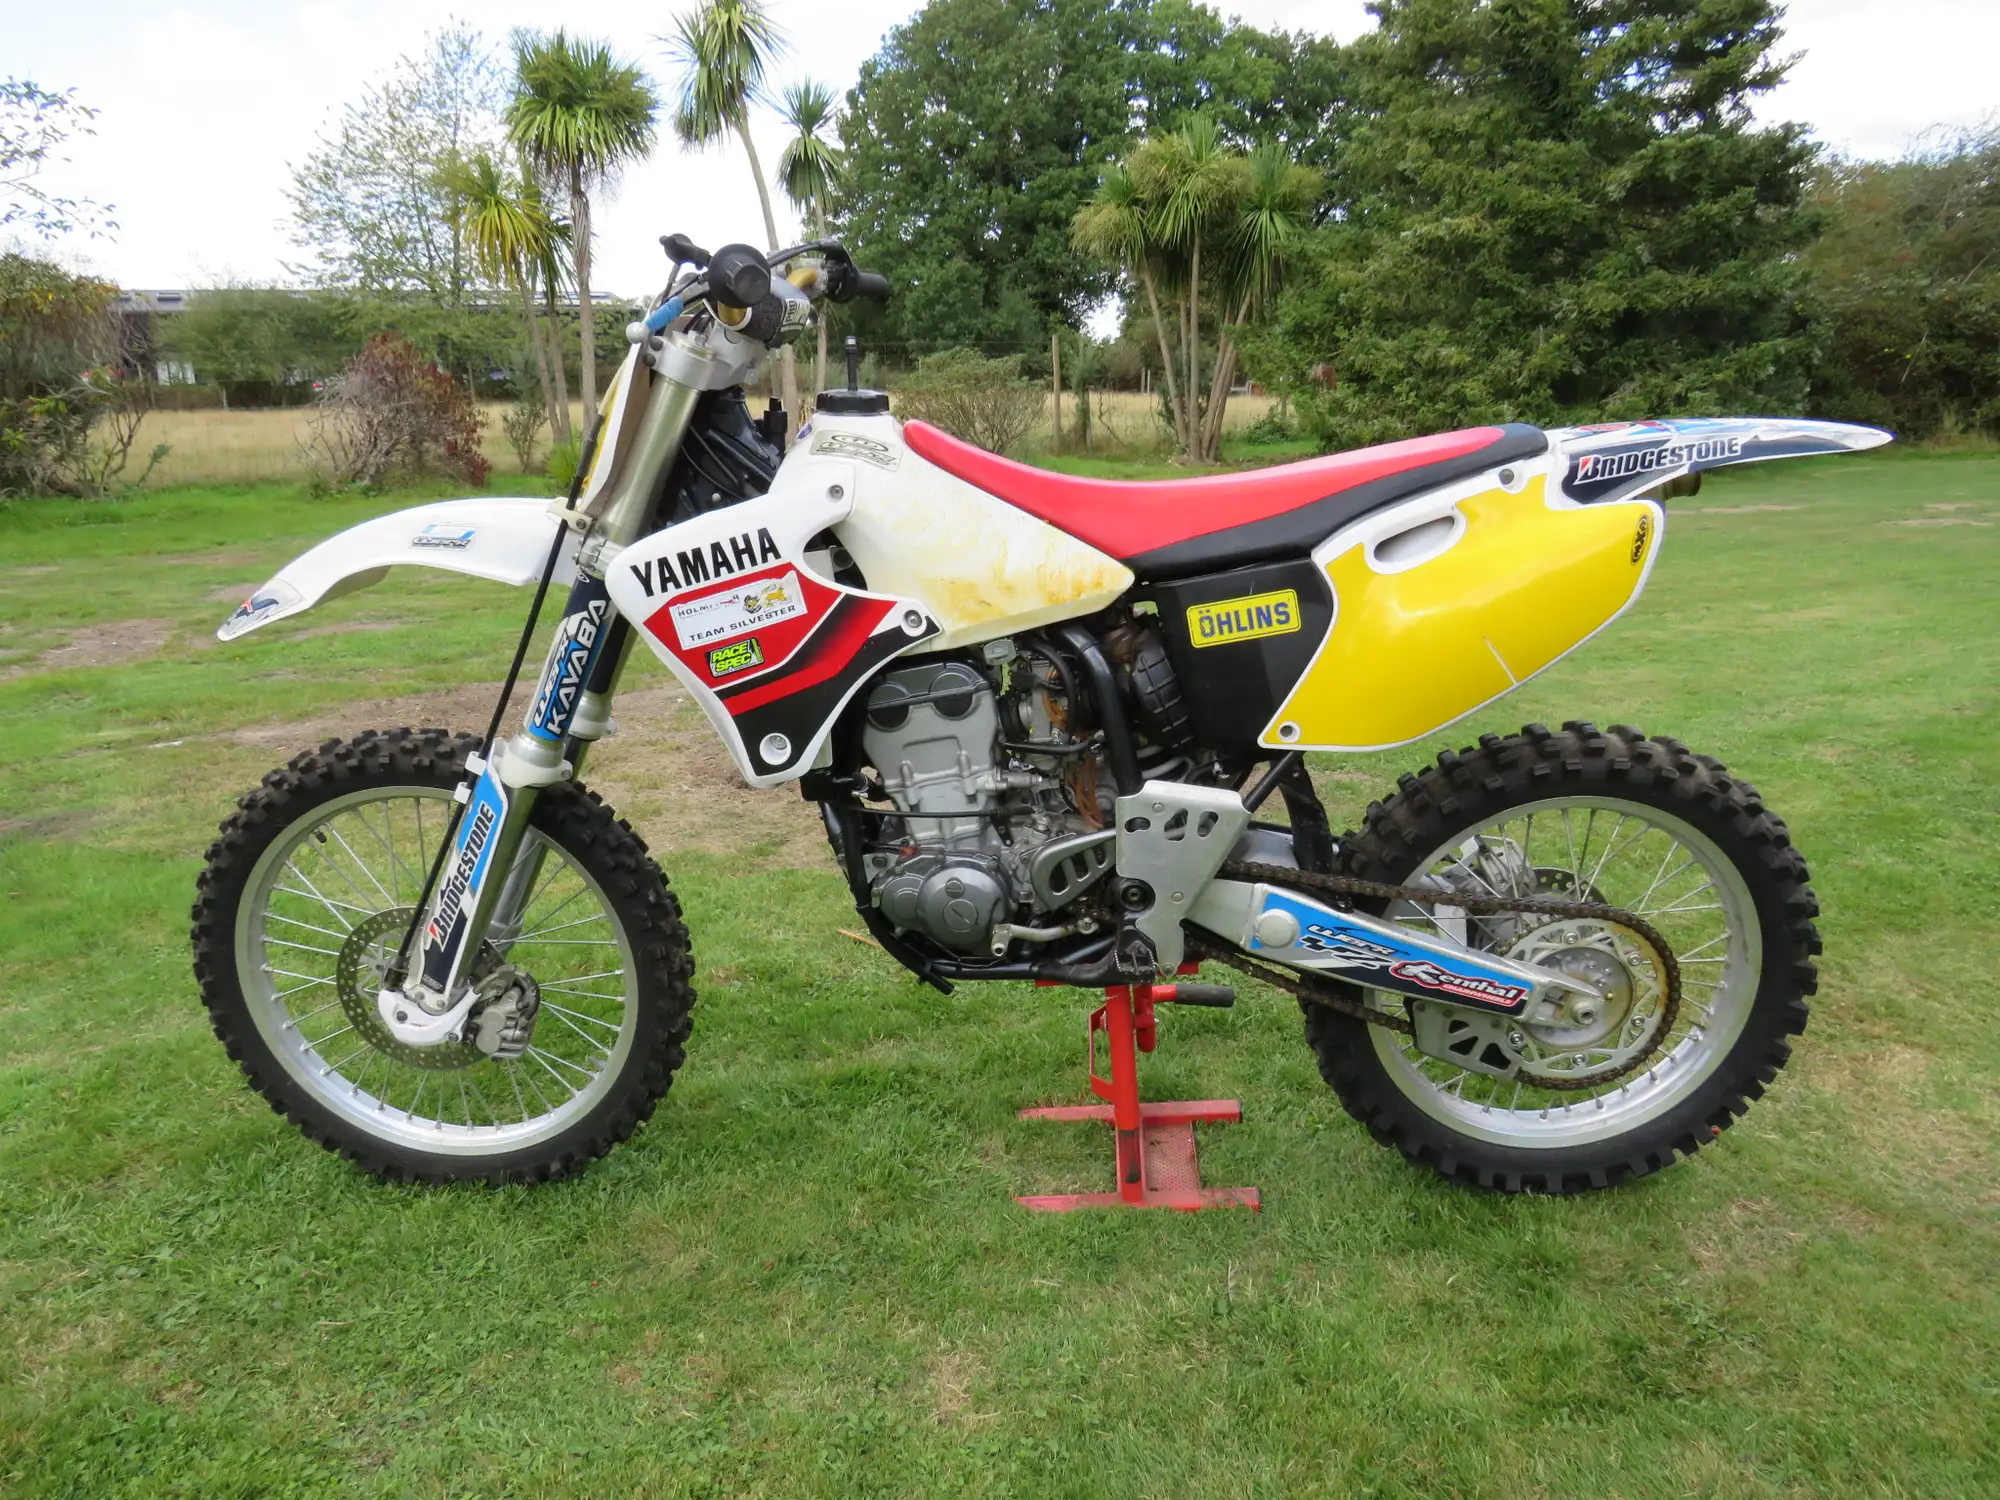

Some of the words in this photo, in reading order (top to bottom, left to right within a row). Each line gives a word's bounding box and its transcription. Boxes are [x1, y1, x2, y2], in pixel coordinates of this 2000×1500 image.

[1573, 437, 1741, 485] BRIDGESTONE
[630, 527, 782, 597] YAMAHA
[690, 627, 725, 641] TEAM
[729, 604, 796, 630] SILVESTER
[1198, 602, 1291, 639] ÖHLINS
[547, 599, 607, 735] KAYABA
[712, 642, 748, 662] RACE
[716, 653, 752, 672] SPEC
[428, 800, 495, 952] BRIDGESTONE
